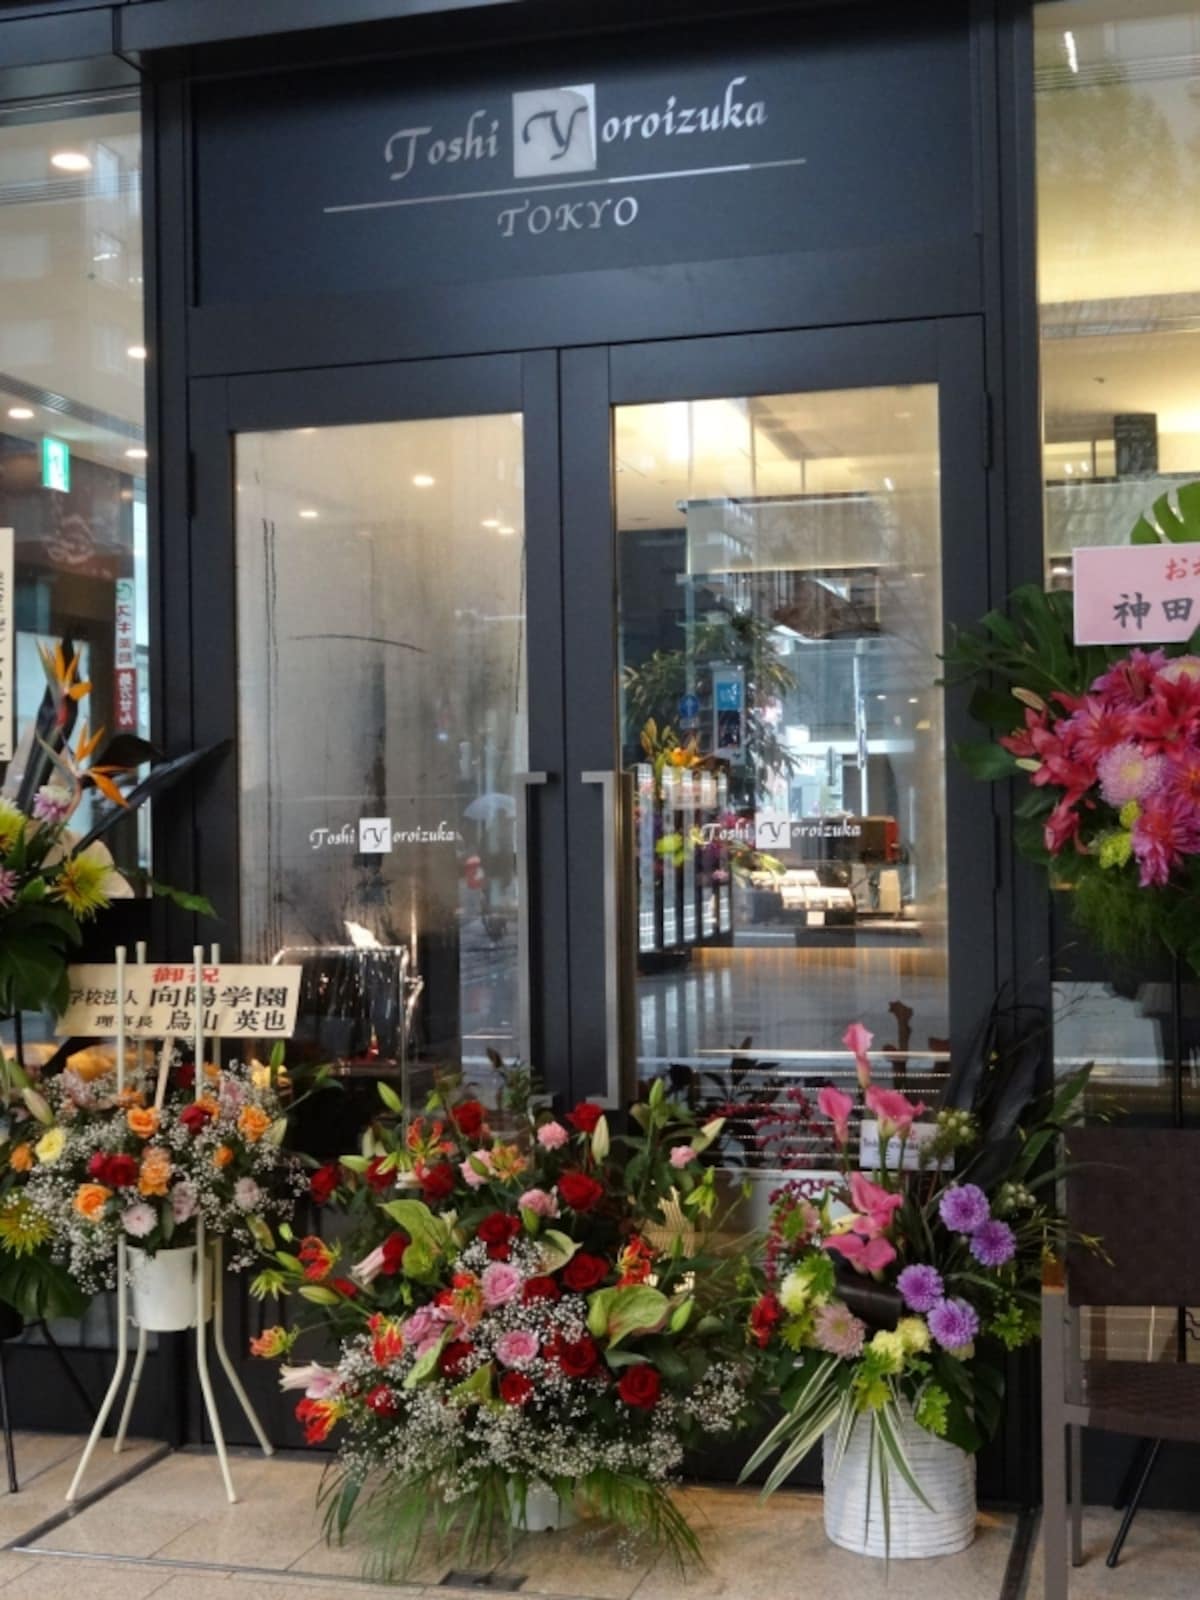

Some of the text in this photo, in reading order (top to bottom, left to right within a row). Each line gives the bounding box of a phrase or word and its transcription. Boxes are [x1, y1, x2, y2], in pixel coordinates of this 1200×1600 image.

[384, 76, 768, 181] Toshi Yoroizuka
[497, 196, 638, 237] TOKYO
[1113, 592, 1194, 630] 神田
[309, 820, 454, 849] Toshi Yoroizuka
[701, 815, 862, 845] Toshi Yoroizuka
[152, 966, 220, 984] 御祝
[150, 985, 289, 1009] 向陽学園
